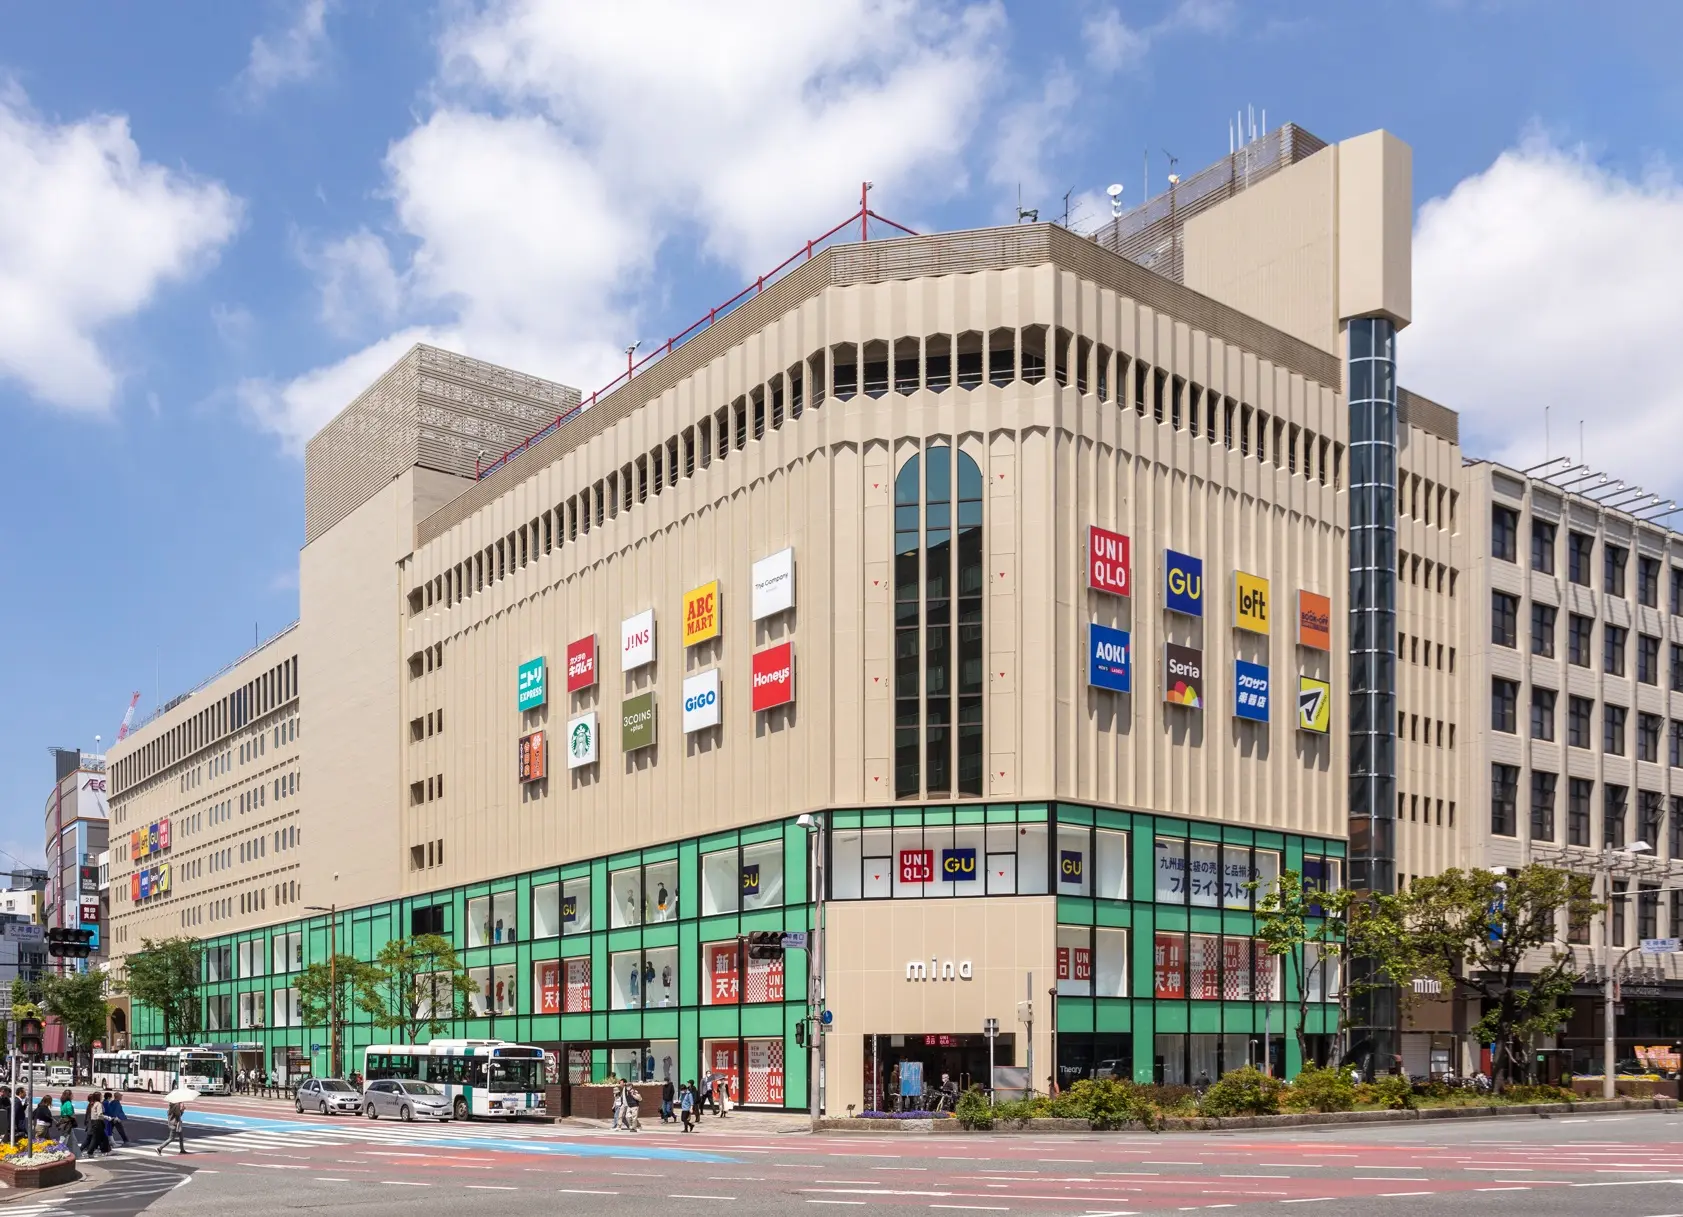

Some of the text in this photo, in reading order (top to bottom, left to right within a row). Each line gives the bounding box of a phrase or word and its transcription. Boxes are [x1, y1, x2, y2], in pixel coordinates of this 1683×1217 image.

[1094, 534, 1123, 563] UNI
[765, 572, 789, 586] Company
[1094, 561, 1126, 587] QLO
[1168, 567, 1201, 600] GU
[687, 592, 713, 621] ABC
[687, 614, 713, 636] MART
[569, 652, 587, 666] カメラの
[1095, 641, 1125, 665] AOKI
[568, 658, 593, 678] キタムラ
[754, 666, 790, 687] Honeys
[1169, 658, 1200, 679] Seria
[520, 665, 542, 690] ニトリ
[1238, 674, 1267, 691] クロサワ
[520, 685, 542, 702] EXPRESS
[685, 690, 716, 712] GiGO
[1238, 691, 1267, 708] 楽器店
[623, 709, 652, 727] 3COINS
[903, 853, 928, 866] UNI
[944, 857, 975, 873] GU
[1062, 858, 1082, 876] GU
[743, 873, 759, 888] GU
[903, 867, 930, 880] QLO
[563, 903, 576, 916] GU
[1076, 952, 1089, 963] UN
[906, 953, 973, 982] mina
[1060, 1065, 1082, 1075] Theory
